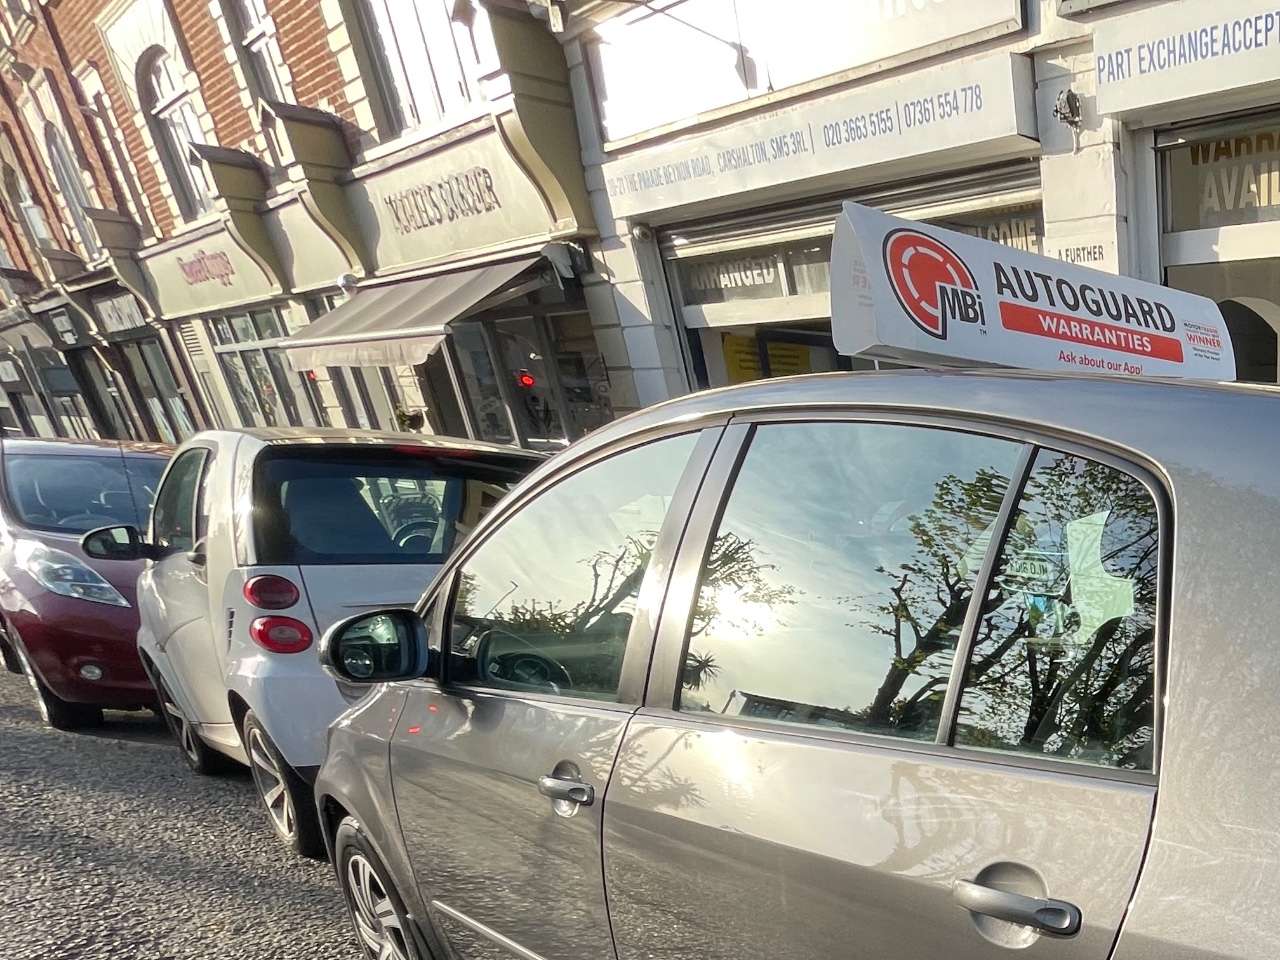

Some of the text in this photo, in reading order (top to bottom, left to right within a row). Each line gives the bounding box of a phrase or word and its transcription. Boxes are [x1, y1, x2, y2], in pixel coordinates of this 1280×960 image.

[1097, 47, 1133, 84] PART
[717, 142, 771, 173] CARSHALTON,
[770, 131, 790, 160] SM5
[790, 128, 808, 155] 3RL
[823, 121, 842, 148] 020
[843, 115, 868, 144] 3663
[869, 108, 894, 137] 5155
[903, 96, 936, 128] 07361
[937, 90, 959, 120] 554
[961, 84, 983, 114] 778
[1066, 245, 1104, 263] FURTHER
[993, 262, 1176, 333] AUTOGUARD
[1038, 313, 1152, 352] WARRANTIES
[1185, 333, 1222, 349] WINNER
[1059, 350, 1076, 364] Ask
[1079, 353, 1105, 369] about
[1107, 360, 1122, 371] our
